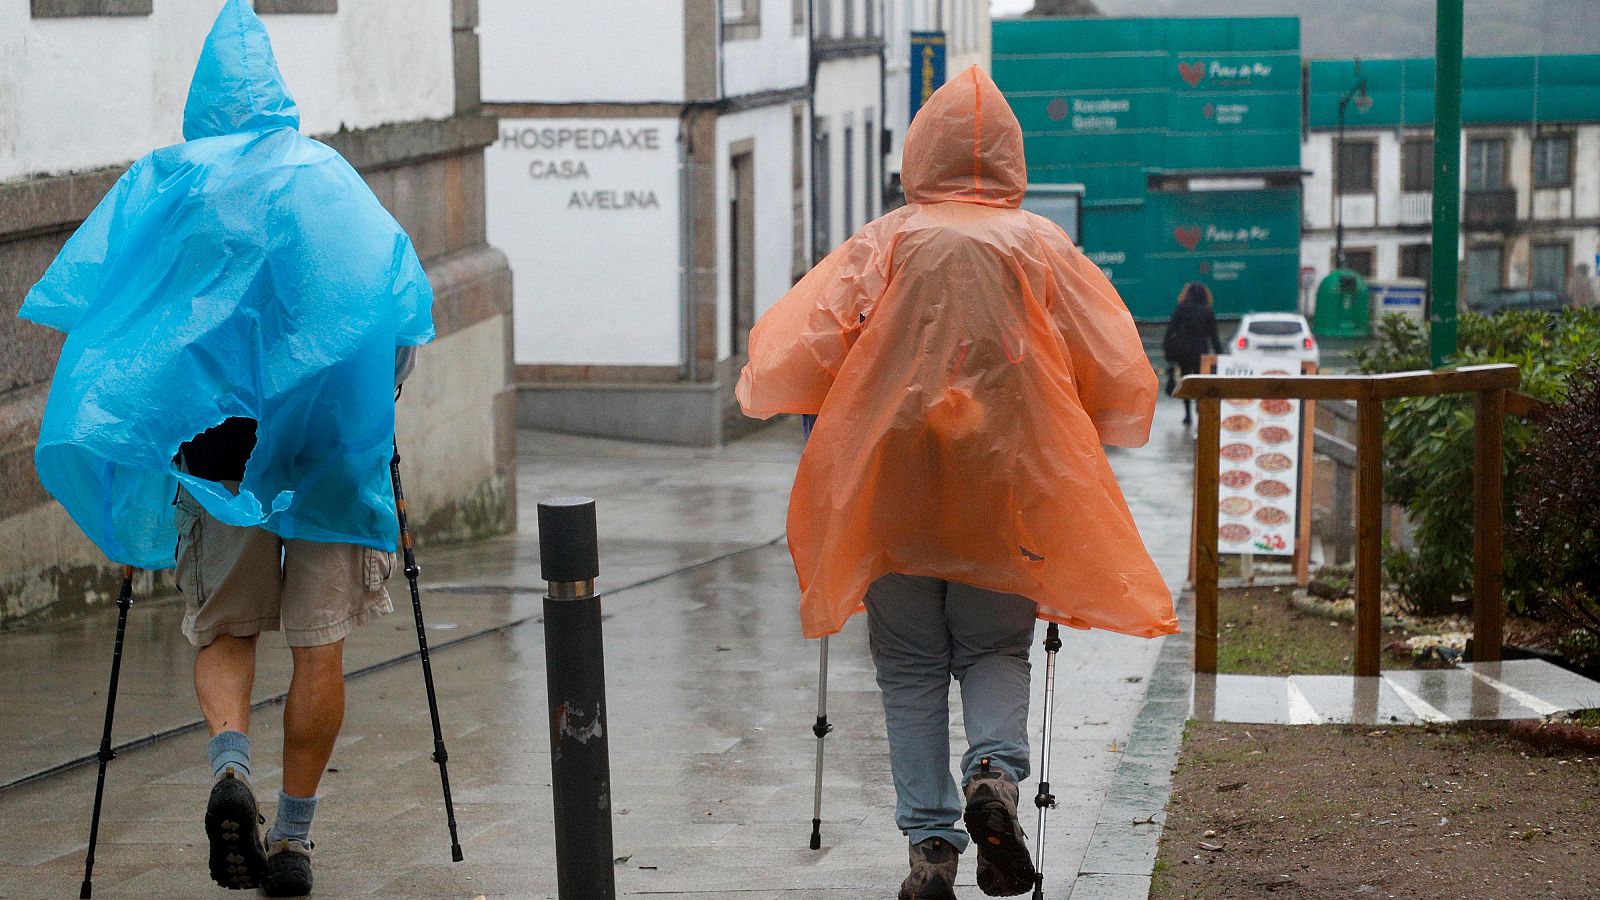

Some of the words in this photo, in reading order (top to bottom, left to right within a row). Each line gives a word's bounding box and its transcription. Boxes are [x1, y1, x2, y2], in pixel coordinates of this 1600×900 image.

[502, 127, 660, 149] HOSPEDAXE
[529, 160, 589, 179] CASA
[567, 189, 660, 209] AVELINA
